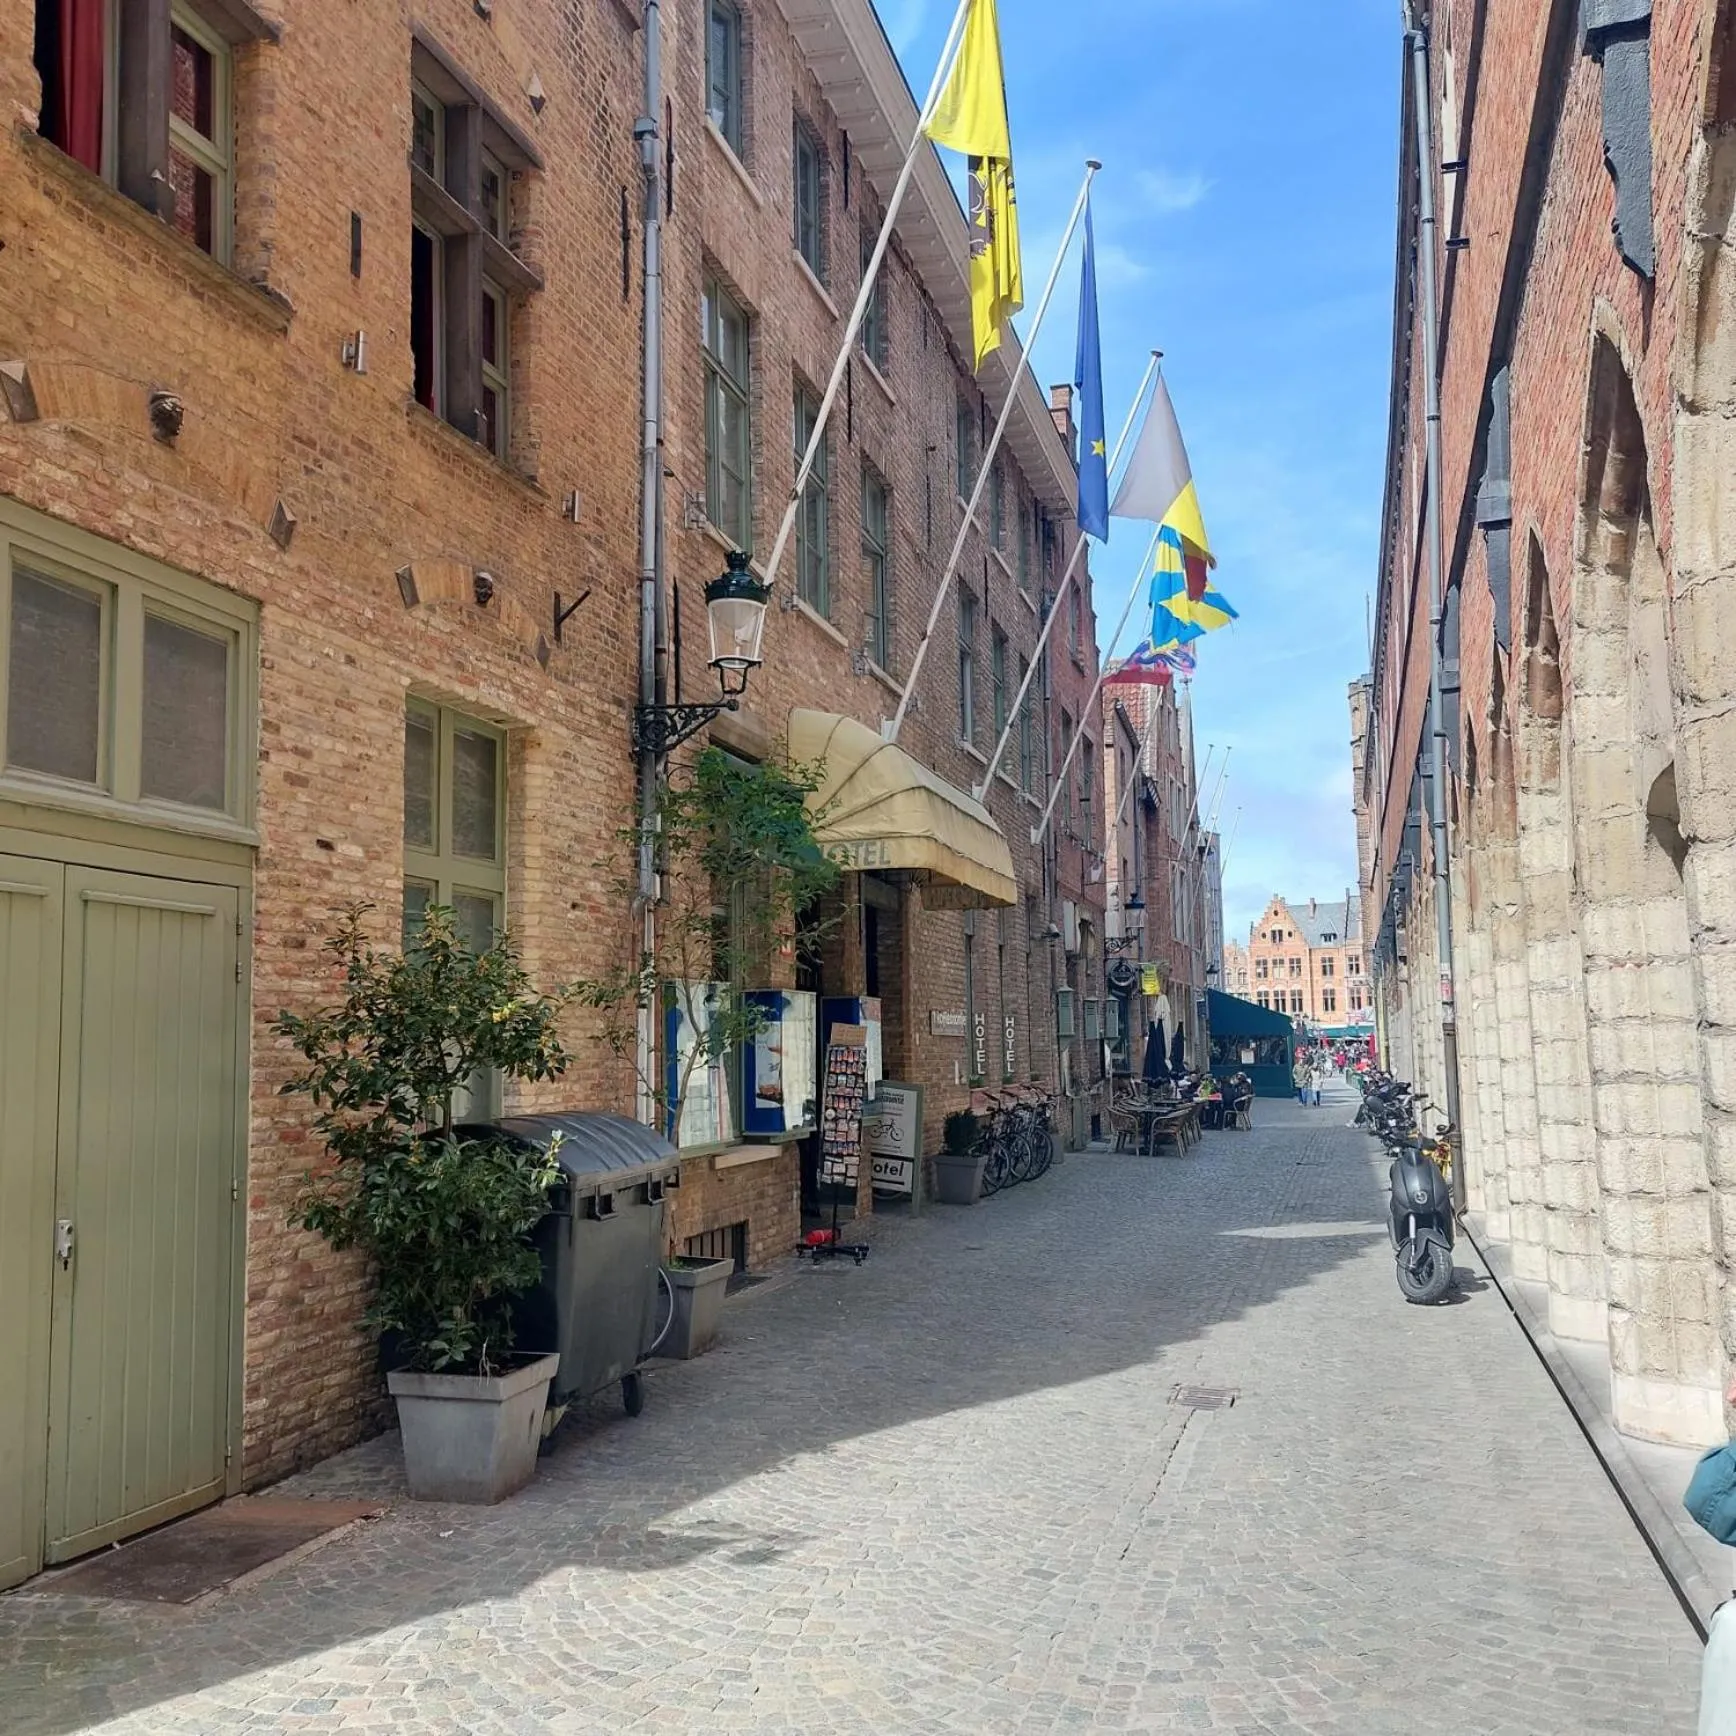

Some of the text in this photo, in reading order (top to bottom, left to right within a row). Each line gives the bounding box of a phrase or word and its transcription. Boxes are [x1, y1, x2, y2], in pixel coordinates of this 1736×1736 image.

[974, 1013, 986, 1075] HOTEL
[1005, 1016, 1015, 1073] HOTEL
[871, 1159, 904, 1177] otel
